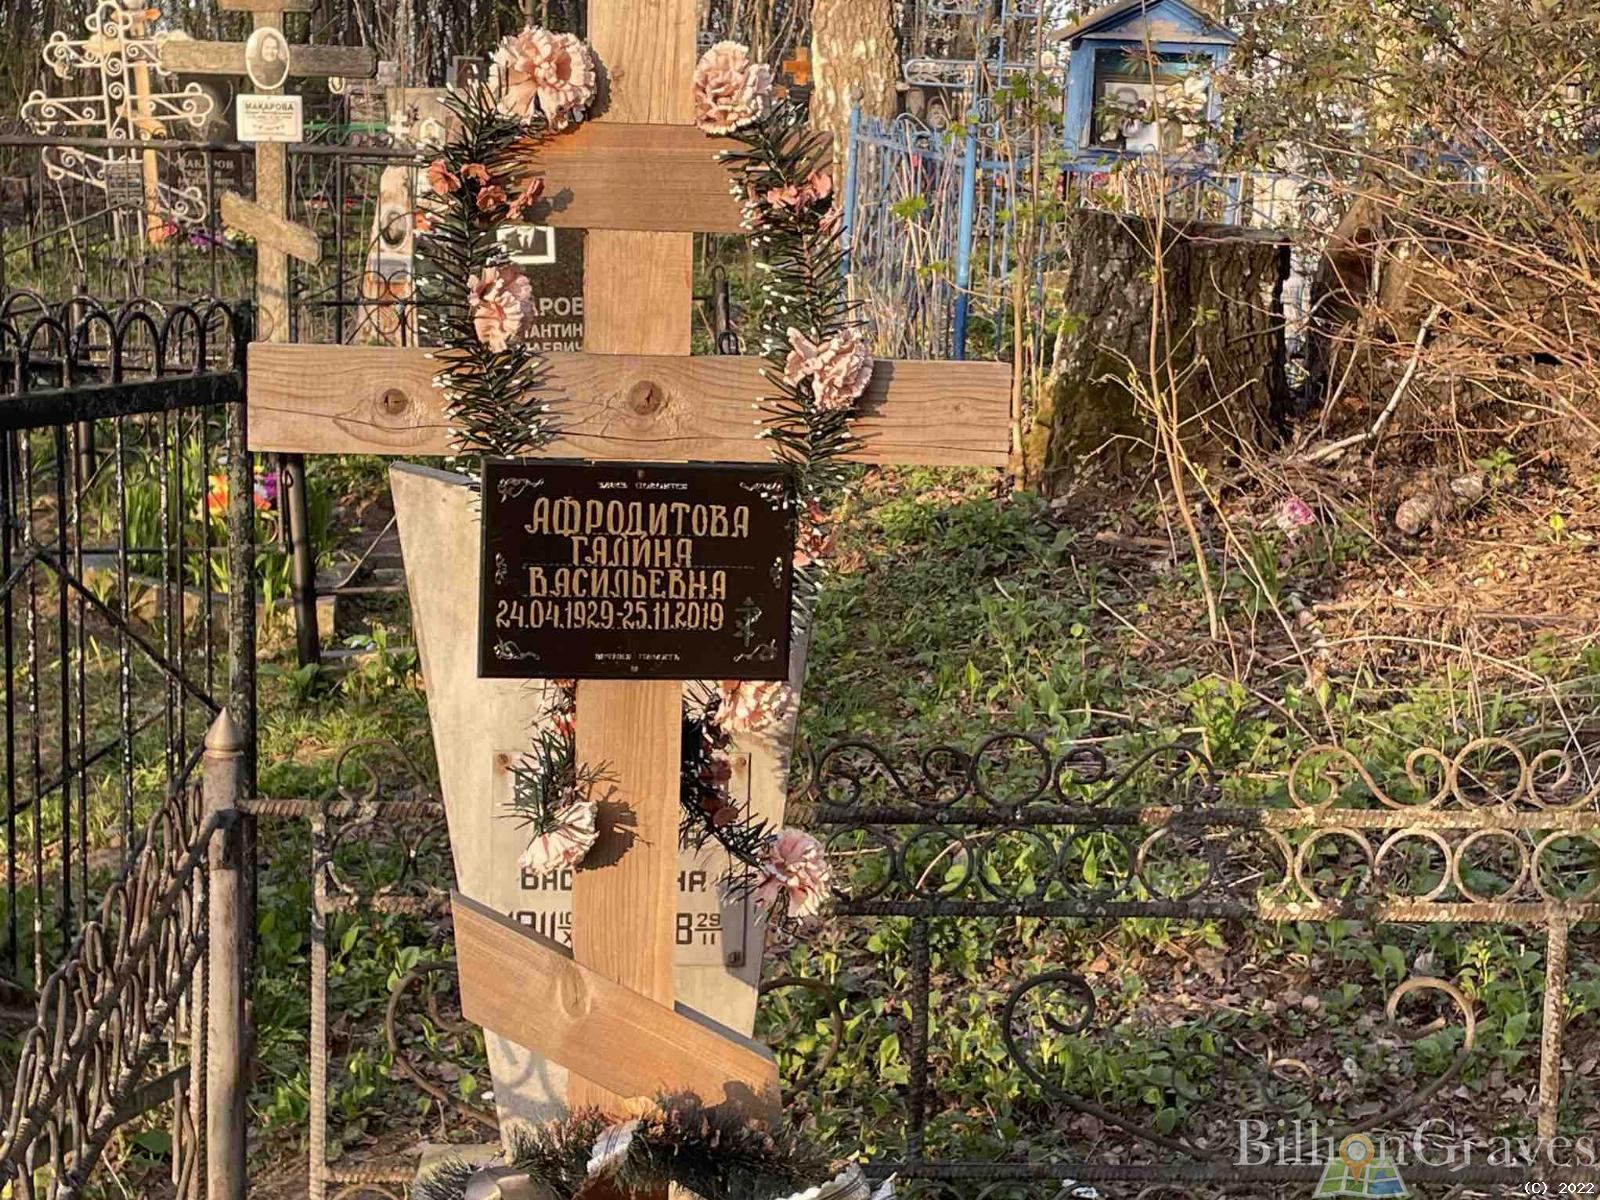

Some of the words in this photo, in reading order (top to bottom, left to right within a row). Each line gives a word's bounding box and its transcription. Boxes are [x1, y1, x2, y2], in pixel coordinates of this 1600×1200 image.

[524, 497, 749, 538] АФРОДИТОВА
[571, 535, 693, 568] ГАЛИНА
[528, 567, 727, 600] ВАСИЛЬЕВНА
